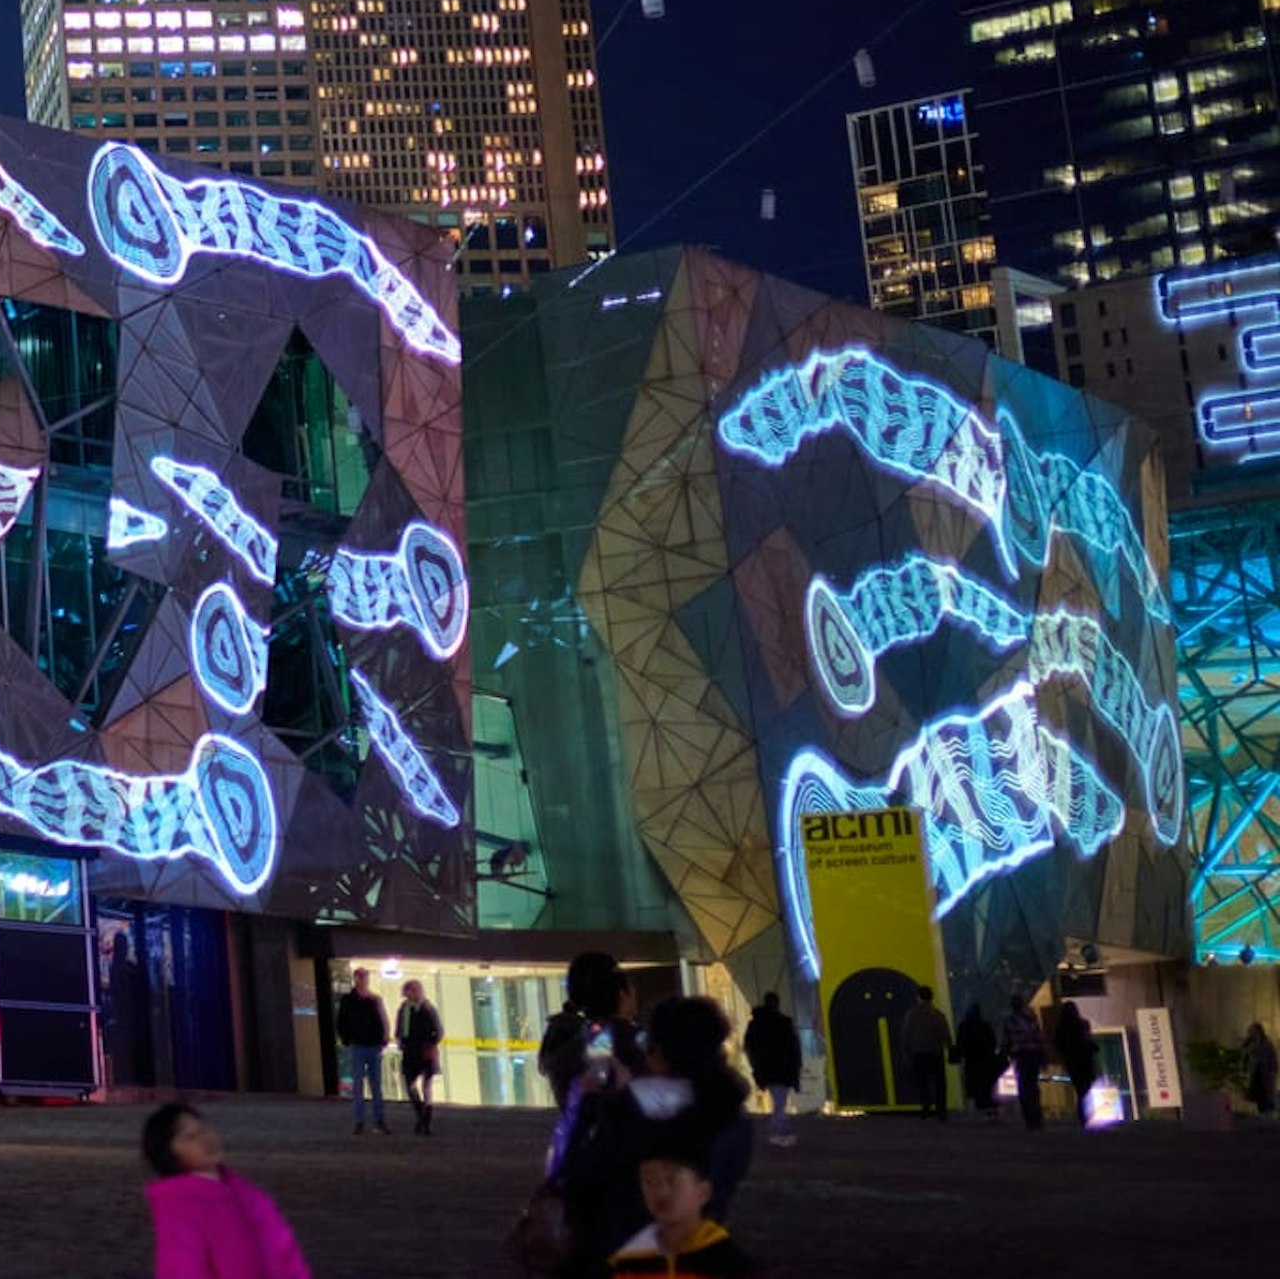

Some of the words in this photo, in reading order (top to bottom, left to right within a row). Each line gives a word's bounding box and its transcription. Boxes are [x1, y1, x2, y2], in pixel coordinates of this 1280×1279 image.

[803, 809, 913, 840] acmi
[807, 844, 835, 855] Your
[838, 841, 894, 854] museum
[825, 856, 869, 868] screen
[870, 853, 917, 866] culture
